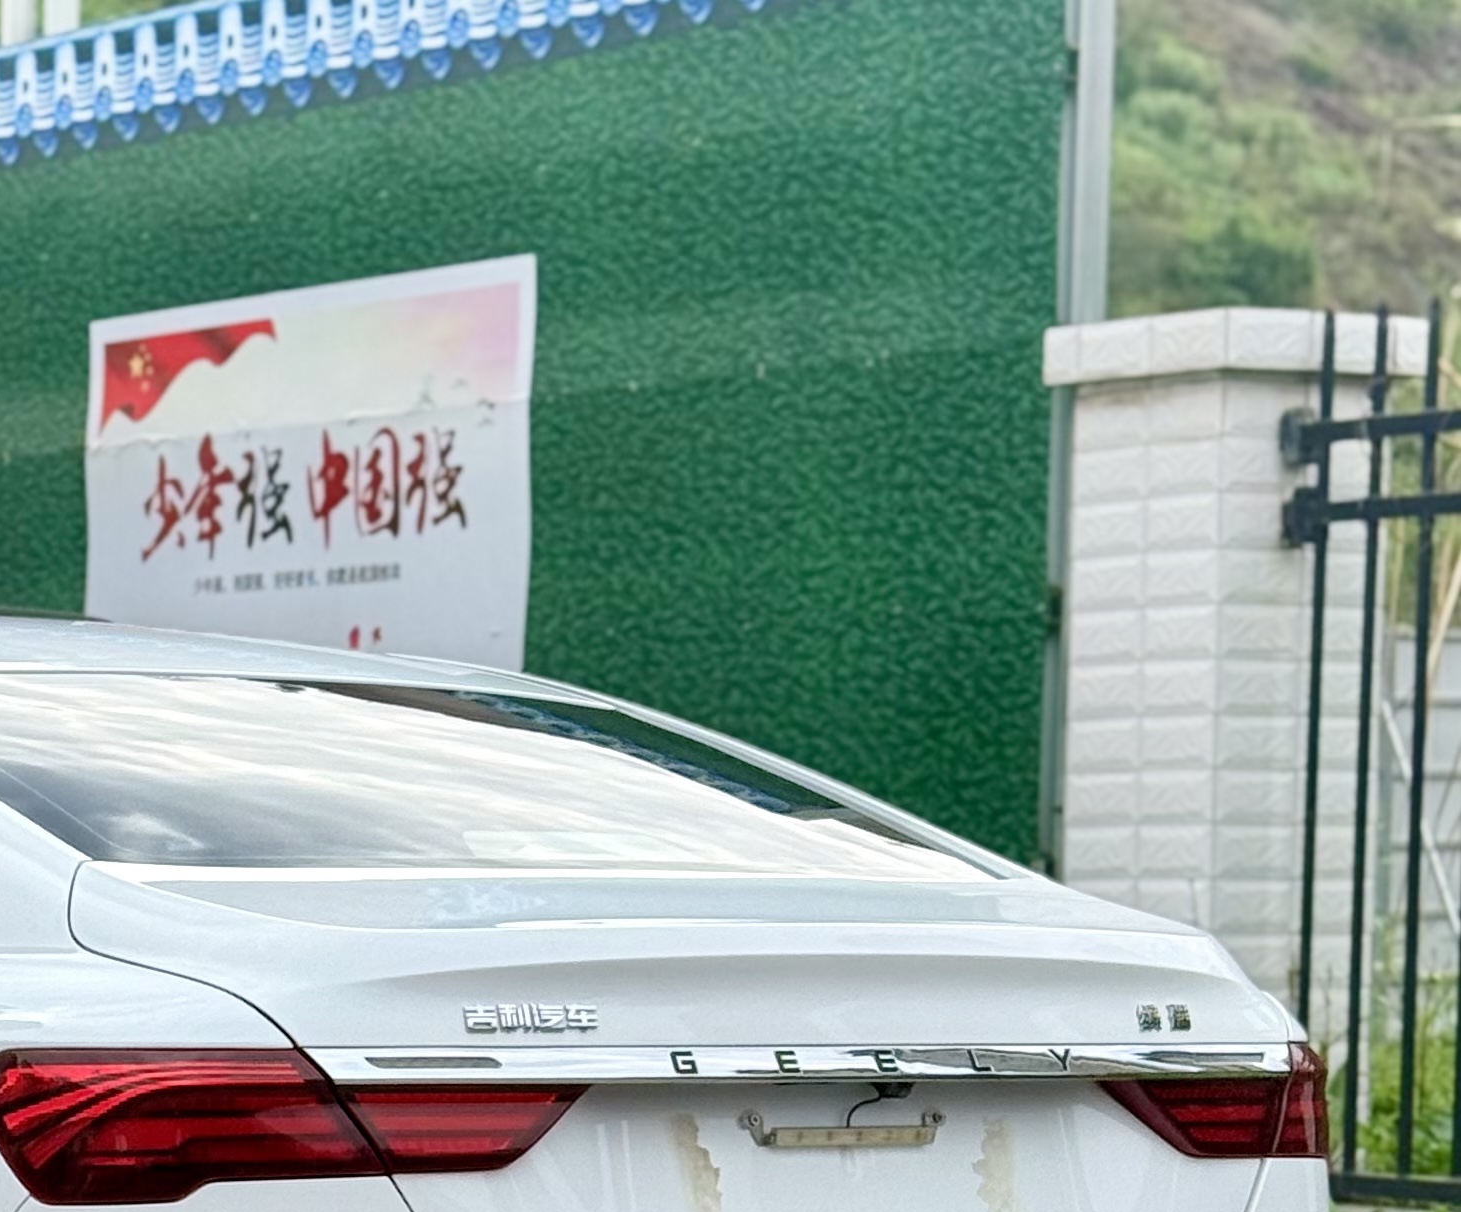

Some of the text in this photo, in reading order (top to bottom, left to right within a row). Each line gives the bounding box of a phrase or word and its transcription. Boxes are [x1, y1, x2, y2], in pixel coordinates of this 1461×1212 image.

[463, 1003, 600, 1034] 吉利汽车
[669, 1047, 1071, 1075] GEELY
